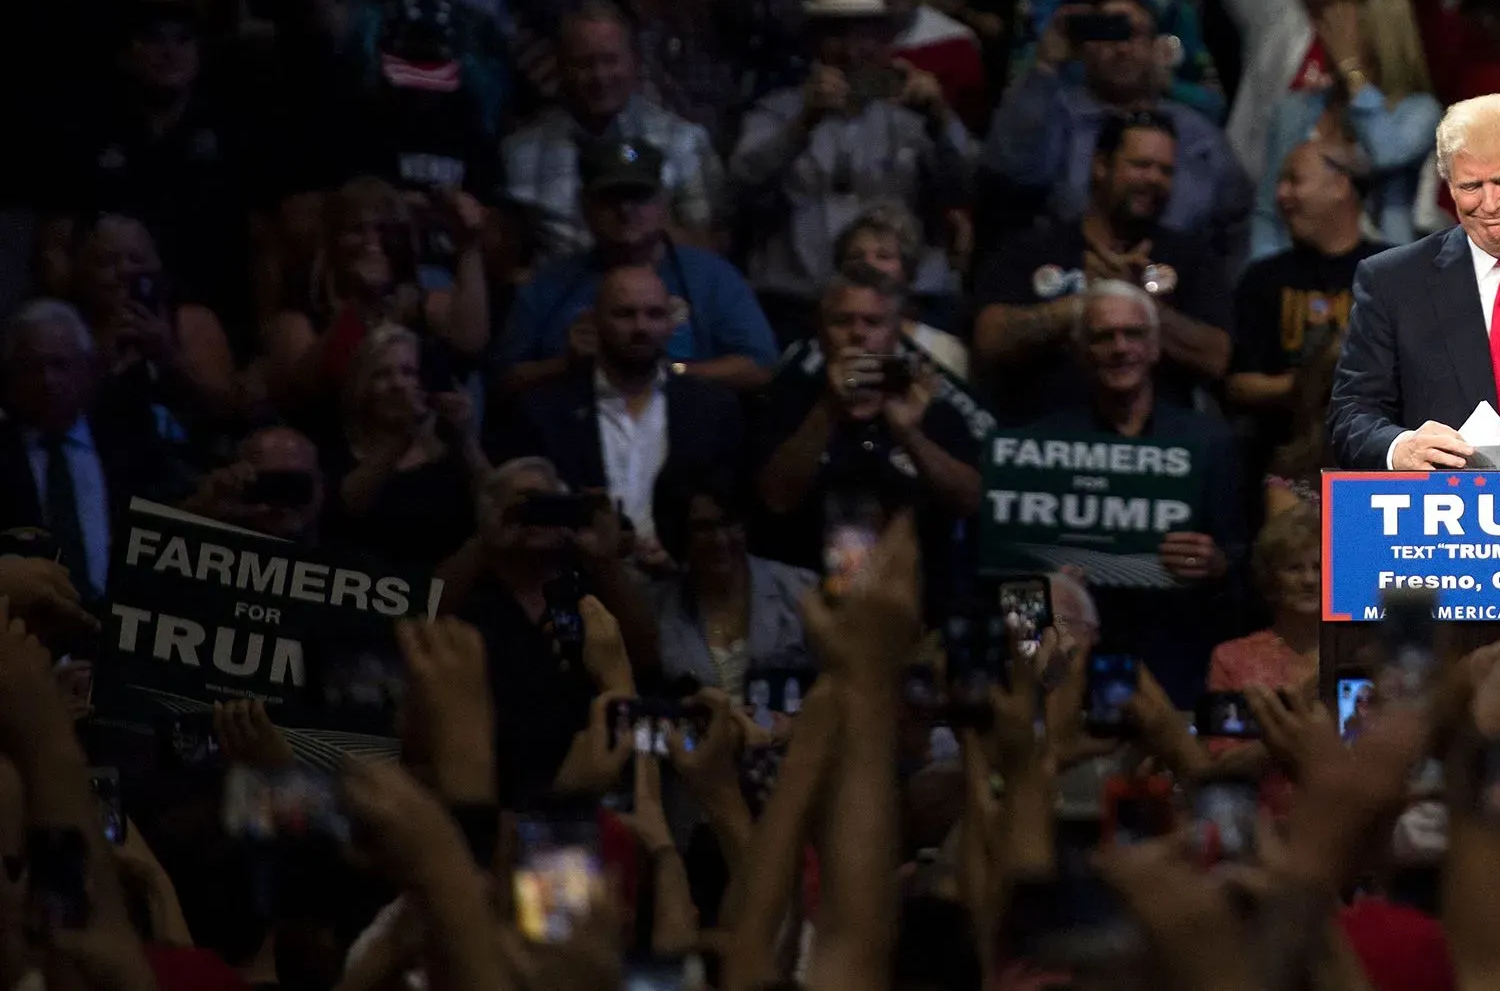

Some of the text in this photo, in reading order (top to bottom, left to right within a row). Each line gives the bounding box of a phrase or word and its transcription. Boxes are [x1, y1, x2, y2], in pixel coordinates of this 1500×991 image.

[991, 437, 1192, 477] FARMERS
[986, 489, 1193, 532] TRUMP
[1391, 546, 1436, 559] TEXT
[125, 527, 411, 616] FARMERS
[1379, 571, 1482, 592] Fresno,
[234, 601, 282, 626] FOR
